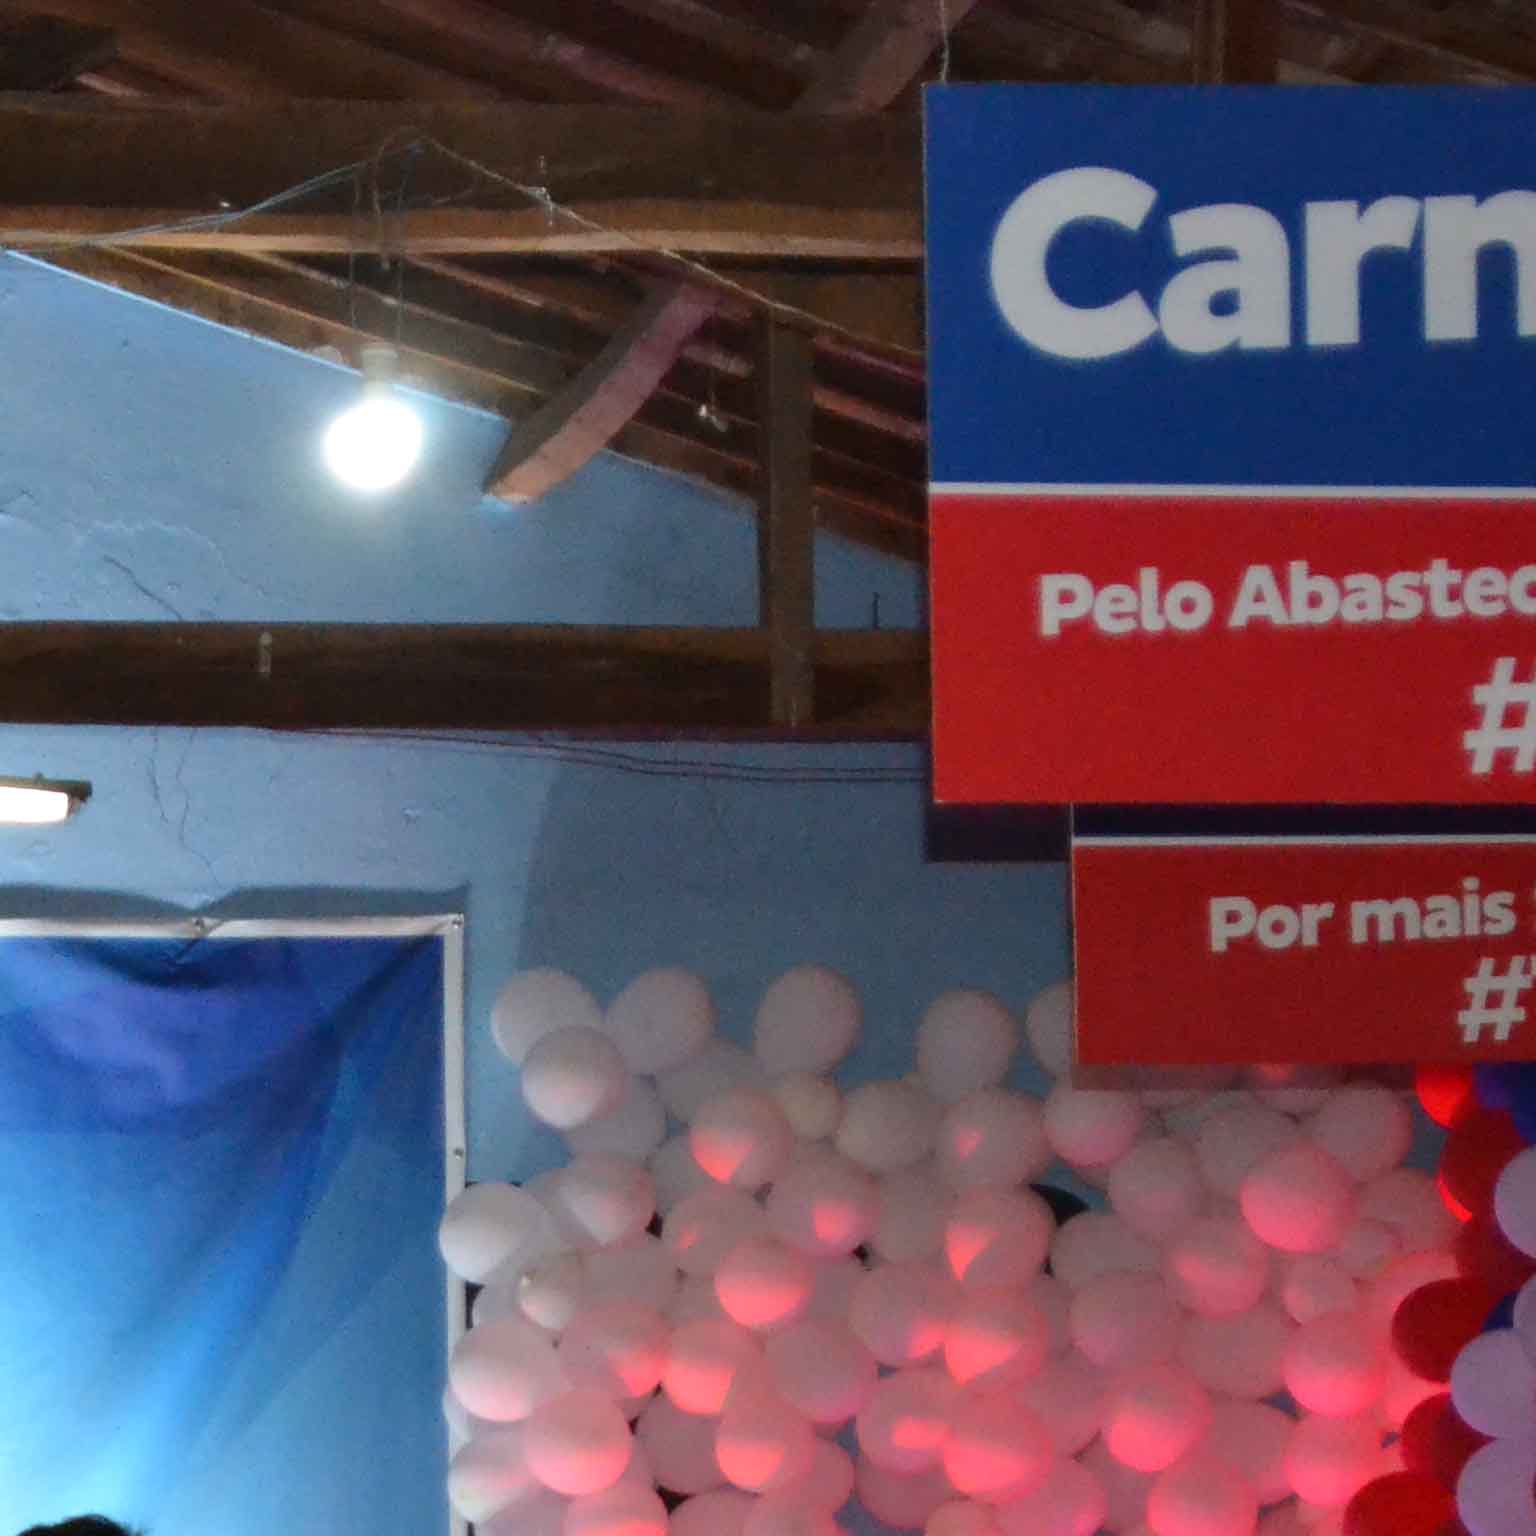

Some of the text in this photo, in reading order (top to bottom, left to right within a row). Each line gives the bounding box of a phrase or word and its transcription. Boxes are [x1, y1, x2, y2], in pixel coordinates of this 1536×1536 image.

[1038, 566, 1214, 637] Pelo
[1209, 876, 1517, 953] Por mais
